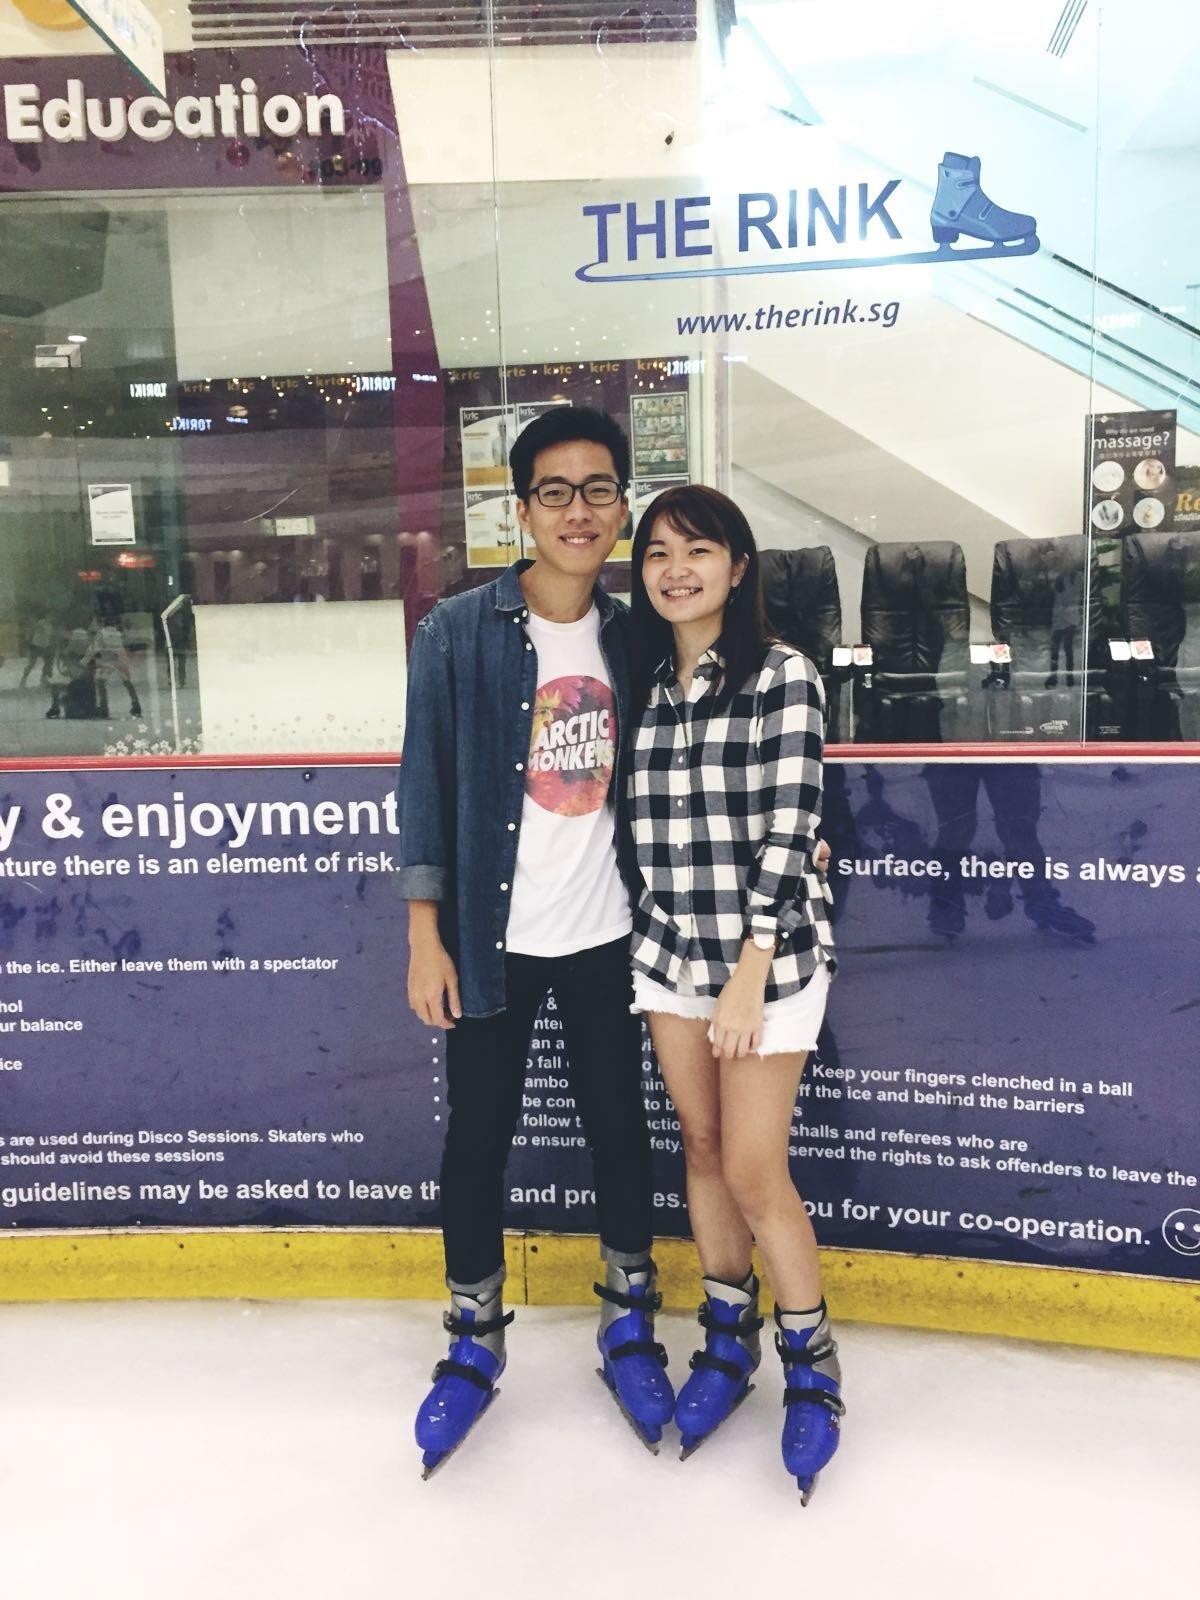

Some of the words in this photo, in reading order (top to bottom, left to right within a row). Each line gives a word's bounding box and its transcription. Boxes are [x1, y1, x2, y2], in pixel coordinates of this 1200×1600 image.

[4, 78, 345, 142] Education
[583, 197, 712, 263] THE
[738, 180, 903, 252] RINK
[677, 299, 900, 335] www.therink.sg
[1094, 431, 1170, 450] massage?
[534, 709, 610, 751] ARCTIC
[41, 792, 85, 839] &
[101, 790, 400, 849] enjoyment
[63, 854, 131, 876] there
[138, 853, 161, 875] is
[167, 858, 199, 875] an
[206, 852, 308, 874] element
[314, 851, 341, 873] of
[347, 851, 401, 873] risk.
[838, 853, 950, 881] surface,
[959, 855, 1035, 879] there
[1045, 856, 1070, 880] is
[1079, 857, 1186, 888] always
[5, 960, 33, 975] the
[36, 960, 65, 974] ice.
[69, 959, 118, 973] Either
[121, 958, 164, 972] leave
[166, 957, 208, 972] them
[211, 956, 246, 971] with
[249, 959, 260, 970] a
[263, 956, 339, 973] spectator
[20, 1018, 83, 1032] balance
[531, 1038, 551, 1050] an
[537, 1055, 562, 1069] fall
[812, 1064, 857, 1083] Keep
[860, 1069, 901, 1084] your
[904, 1068, 967, 1088] fingers
[970, 1072, 1054, 1091] clenched
[1059, 1077, 1077, 1093] in
[1081, 1082, 1093, 1094] a
[1098, 1080, 1133, 1097] ball
[522, 1093, 542, 1108] be
[643, 1097, 661, 1111] to
[814, 1084, 842, 1099] the
[847, 1085, 872, 1101] ice
[876, 1088, 909, 1103] and
[914, 1089, 975, 1107] behind
[979, 1093, 1008, 1109] the
[1013, 1095, 1085, 1115] barriers
[9, 1135, 35, 1147] are
[39, 1132, 79, 1146] used
[82, 1131, 134, 1148] during
[138, 1130, 184, 1144] Disco
[187, 1129, 264, 1144] Sessions.
[267, 1129, 327, 1143] Skaters
[331, 1129, 364, 1143] who
[522, 1113, 571, 1128] follow
[844, 1127, 876, 1141] and
[881, 1128, 952, 1147] referees
[956, 1134, 995, 1150] who
[999, 1139, 1028, 1152] are
[0, 1151, 56, 1166] should
[59, 1150, 103, 1165] avoid
[106, 1150, 151, 1163] these
[154, 1148, 225, 1163] sessions
[531, 1135, 586, 1147] ensure
[788, 1145, 846, 1161] served
[849, 1146, 877, 1162] the
[882, 1148, 932, 1167] rights
[936, 1152, 955, 1167] to
[959, 1155, 991, 1170] ask
[995, 1157, 1083, 1177] offenders
[1087, 1164, 1107, 1179] to
[1112, 1165, 1162, 1184] leave
[1166, 1170, 1198, 1187] the
[1, 1181, 132, 1208] guidelines
[139, 1184, 191, 1205] may
[198, 1179, 229, 1200] be
[236, 1179, 309, 1199] asked
[315, 1180, 341, 1200] to
[348, 1179, 413, 1200] leave
[510, 1183, 556, 1204] and
[564, 1189, 596, 1209] pr
[841, 1198, 881, 1221] for
[887, 1206, 951, 1228] your
[958, 1212, 1151, 1245] co-operation.
